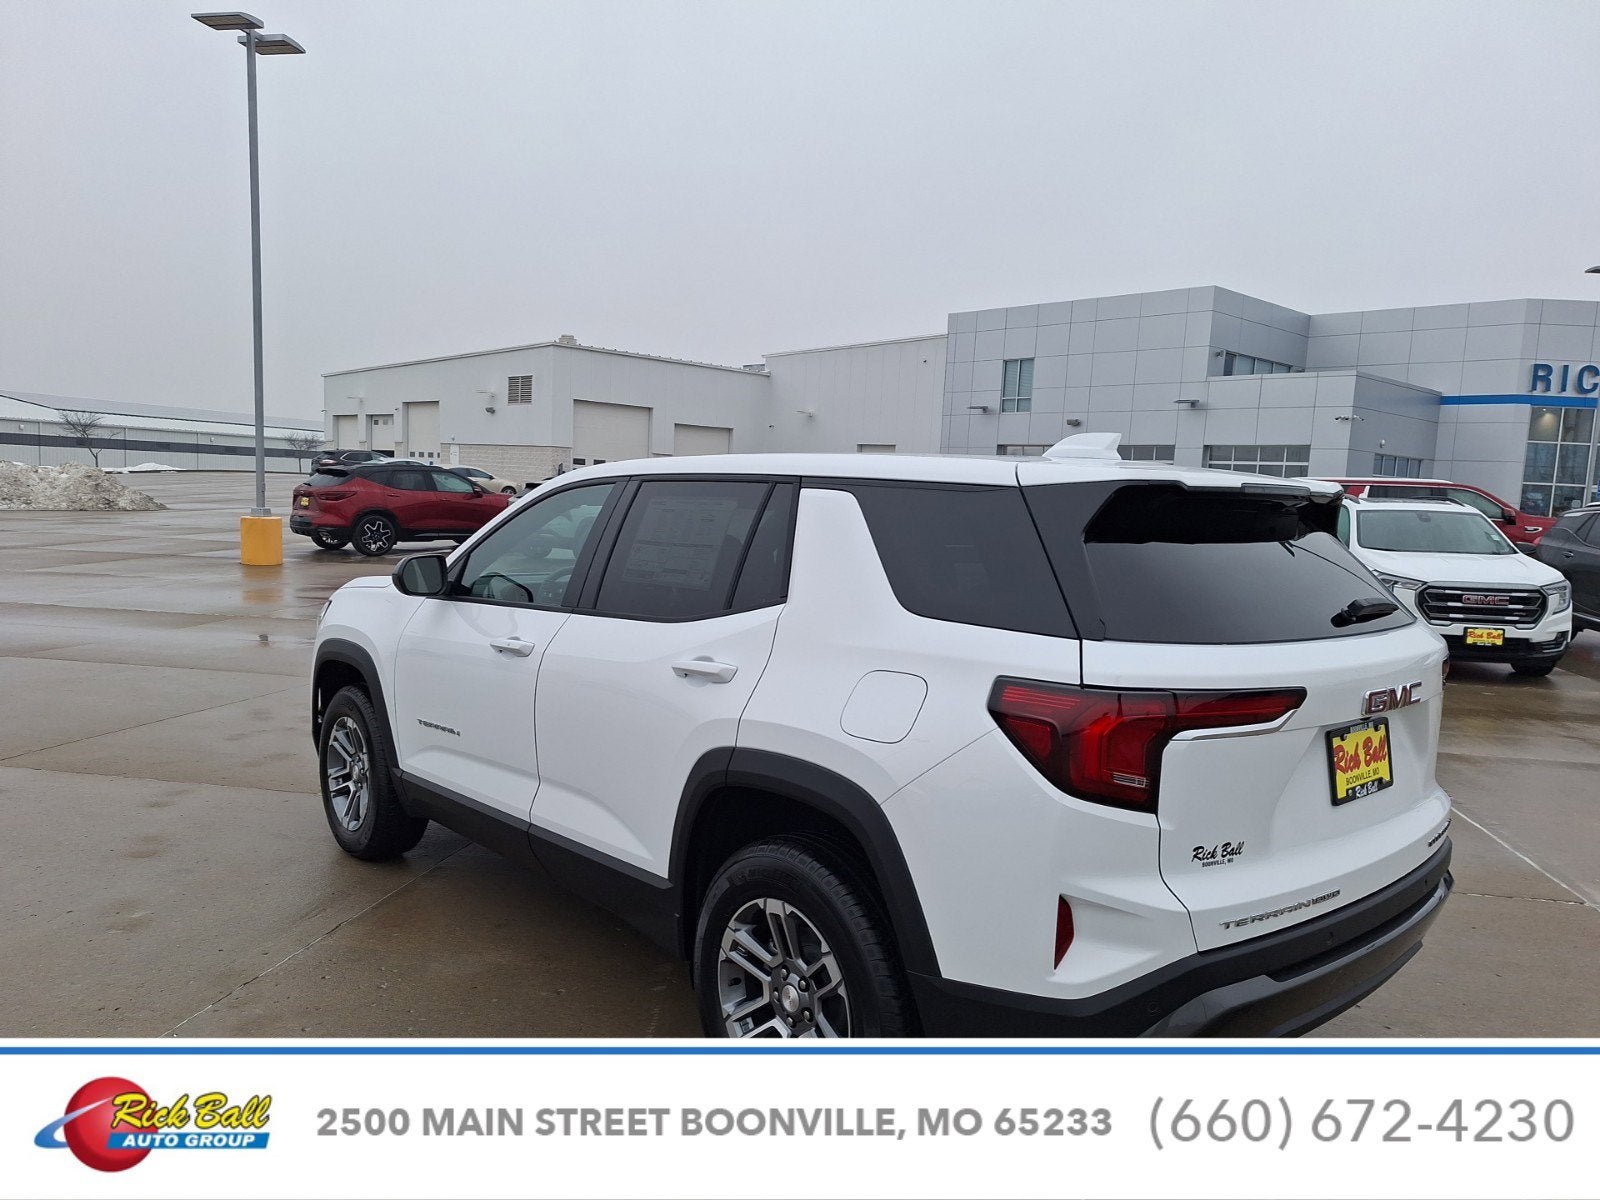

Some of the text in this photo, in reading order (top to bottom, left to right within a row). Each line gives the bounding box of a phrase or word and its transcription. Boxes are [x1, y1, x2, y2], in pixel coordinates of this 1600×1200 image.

[1462, 594, 1510, 606] GMC
[1361, 680, 1422, 716] GMC
[1333, 735, 1388, 775] Rick Ball
[1191, 841, 1245, 862] Rick Ball
[1219, 899, 1311, 930] TERRAIN
